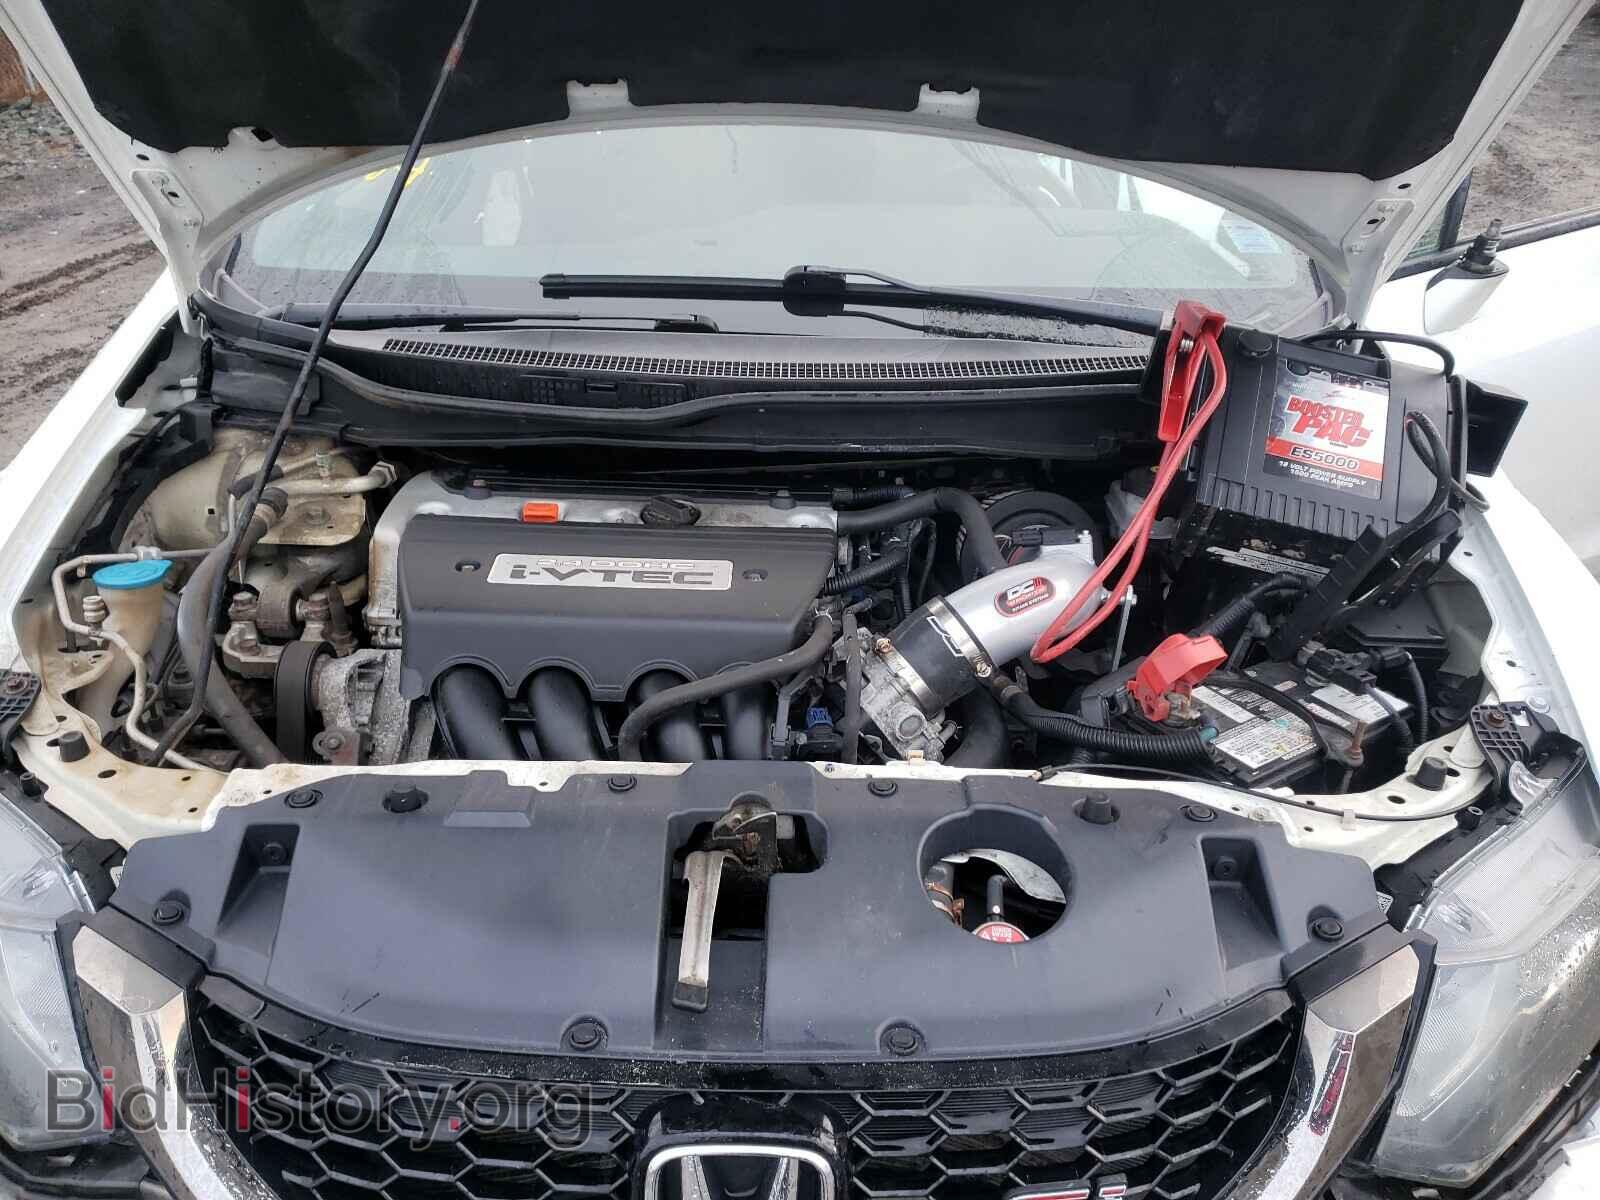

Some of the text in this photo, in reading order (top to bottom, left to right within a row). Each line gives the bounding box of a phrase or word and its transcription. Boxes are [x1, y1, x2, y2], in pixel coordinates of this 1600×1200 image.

[1286, 396, 1364, 425] BOOSTER
[1292, 412, 1371, 447] PAC
[1291, 446, 1358, 470] ES5000
[1290, 463, 1309, 472] VOLT
[1309, 466, 1337, 478] POWER
[1337, 473, 1367, 486] SUPPLY
[1311, 473, 1329, 482] PEAK
[1330, 477, 1354, 488] AMPS
[510, 564, 713, 585] i-VTEC
